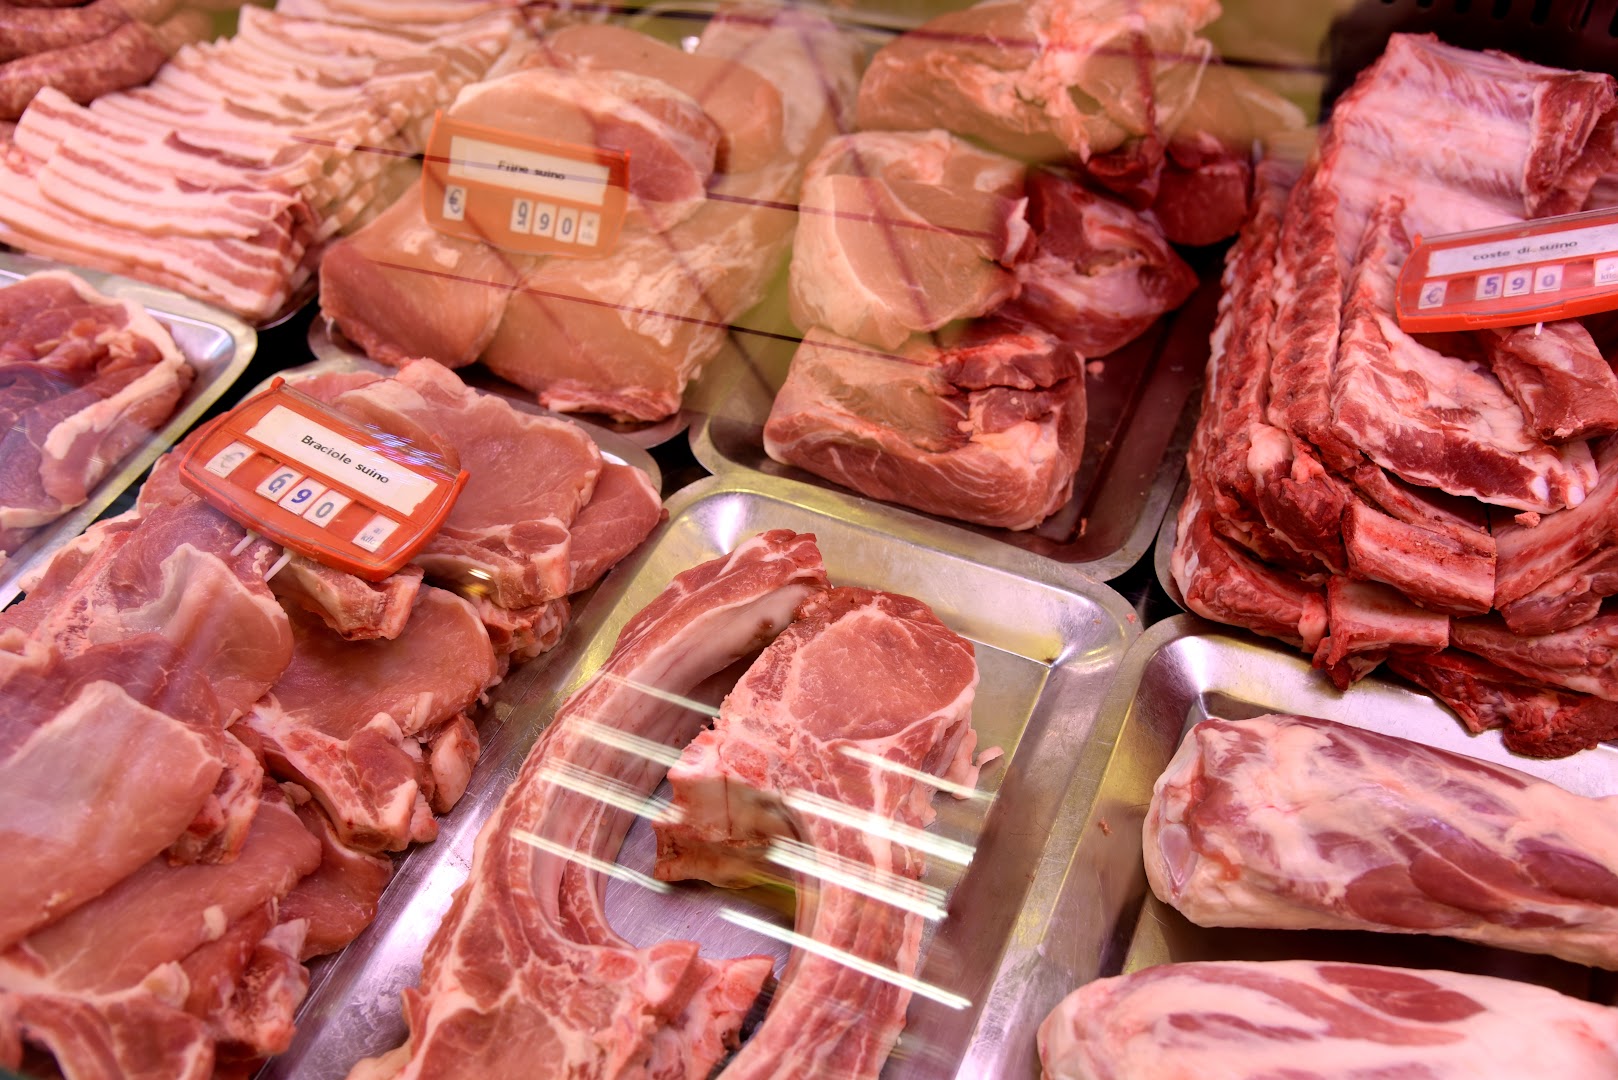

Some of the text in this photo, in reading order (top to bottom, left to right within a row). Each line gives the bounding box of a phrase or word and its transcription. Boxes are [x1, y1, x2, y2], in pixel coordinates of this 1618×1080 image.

[534, 168, 567, 181] suino
[1472, 248, 1511, 261] coste
[1539, 240, 1578, 252] suino
[300, 434, 390, 485] Braciole suino
